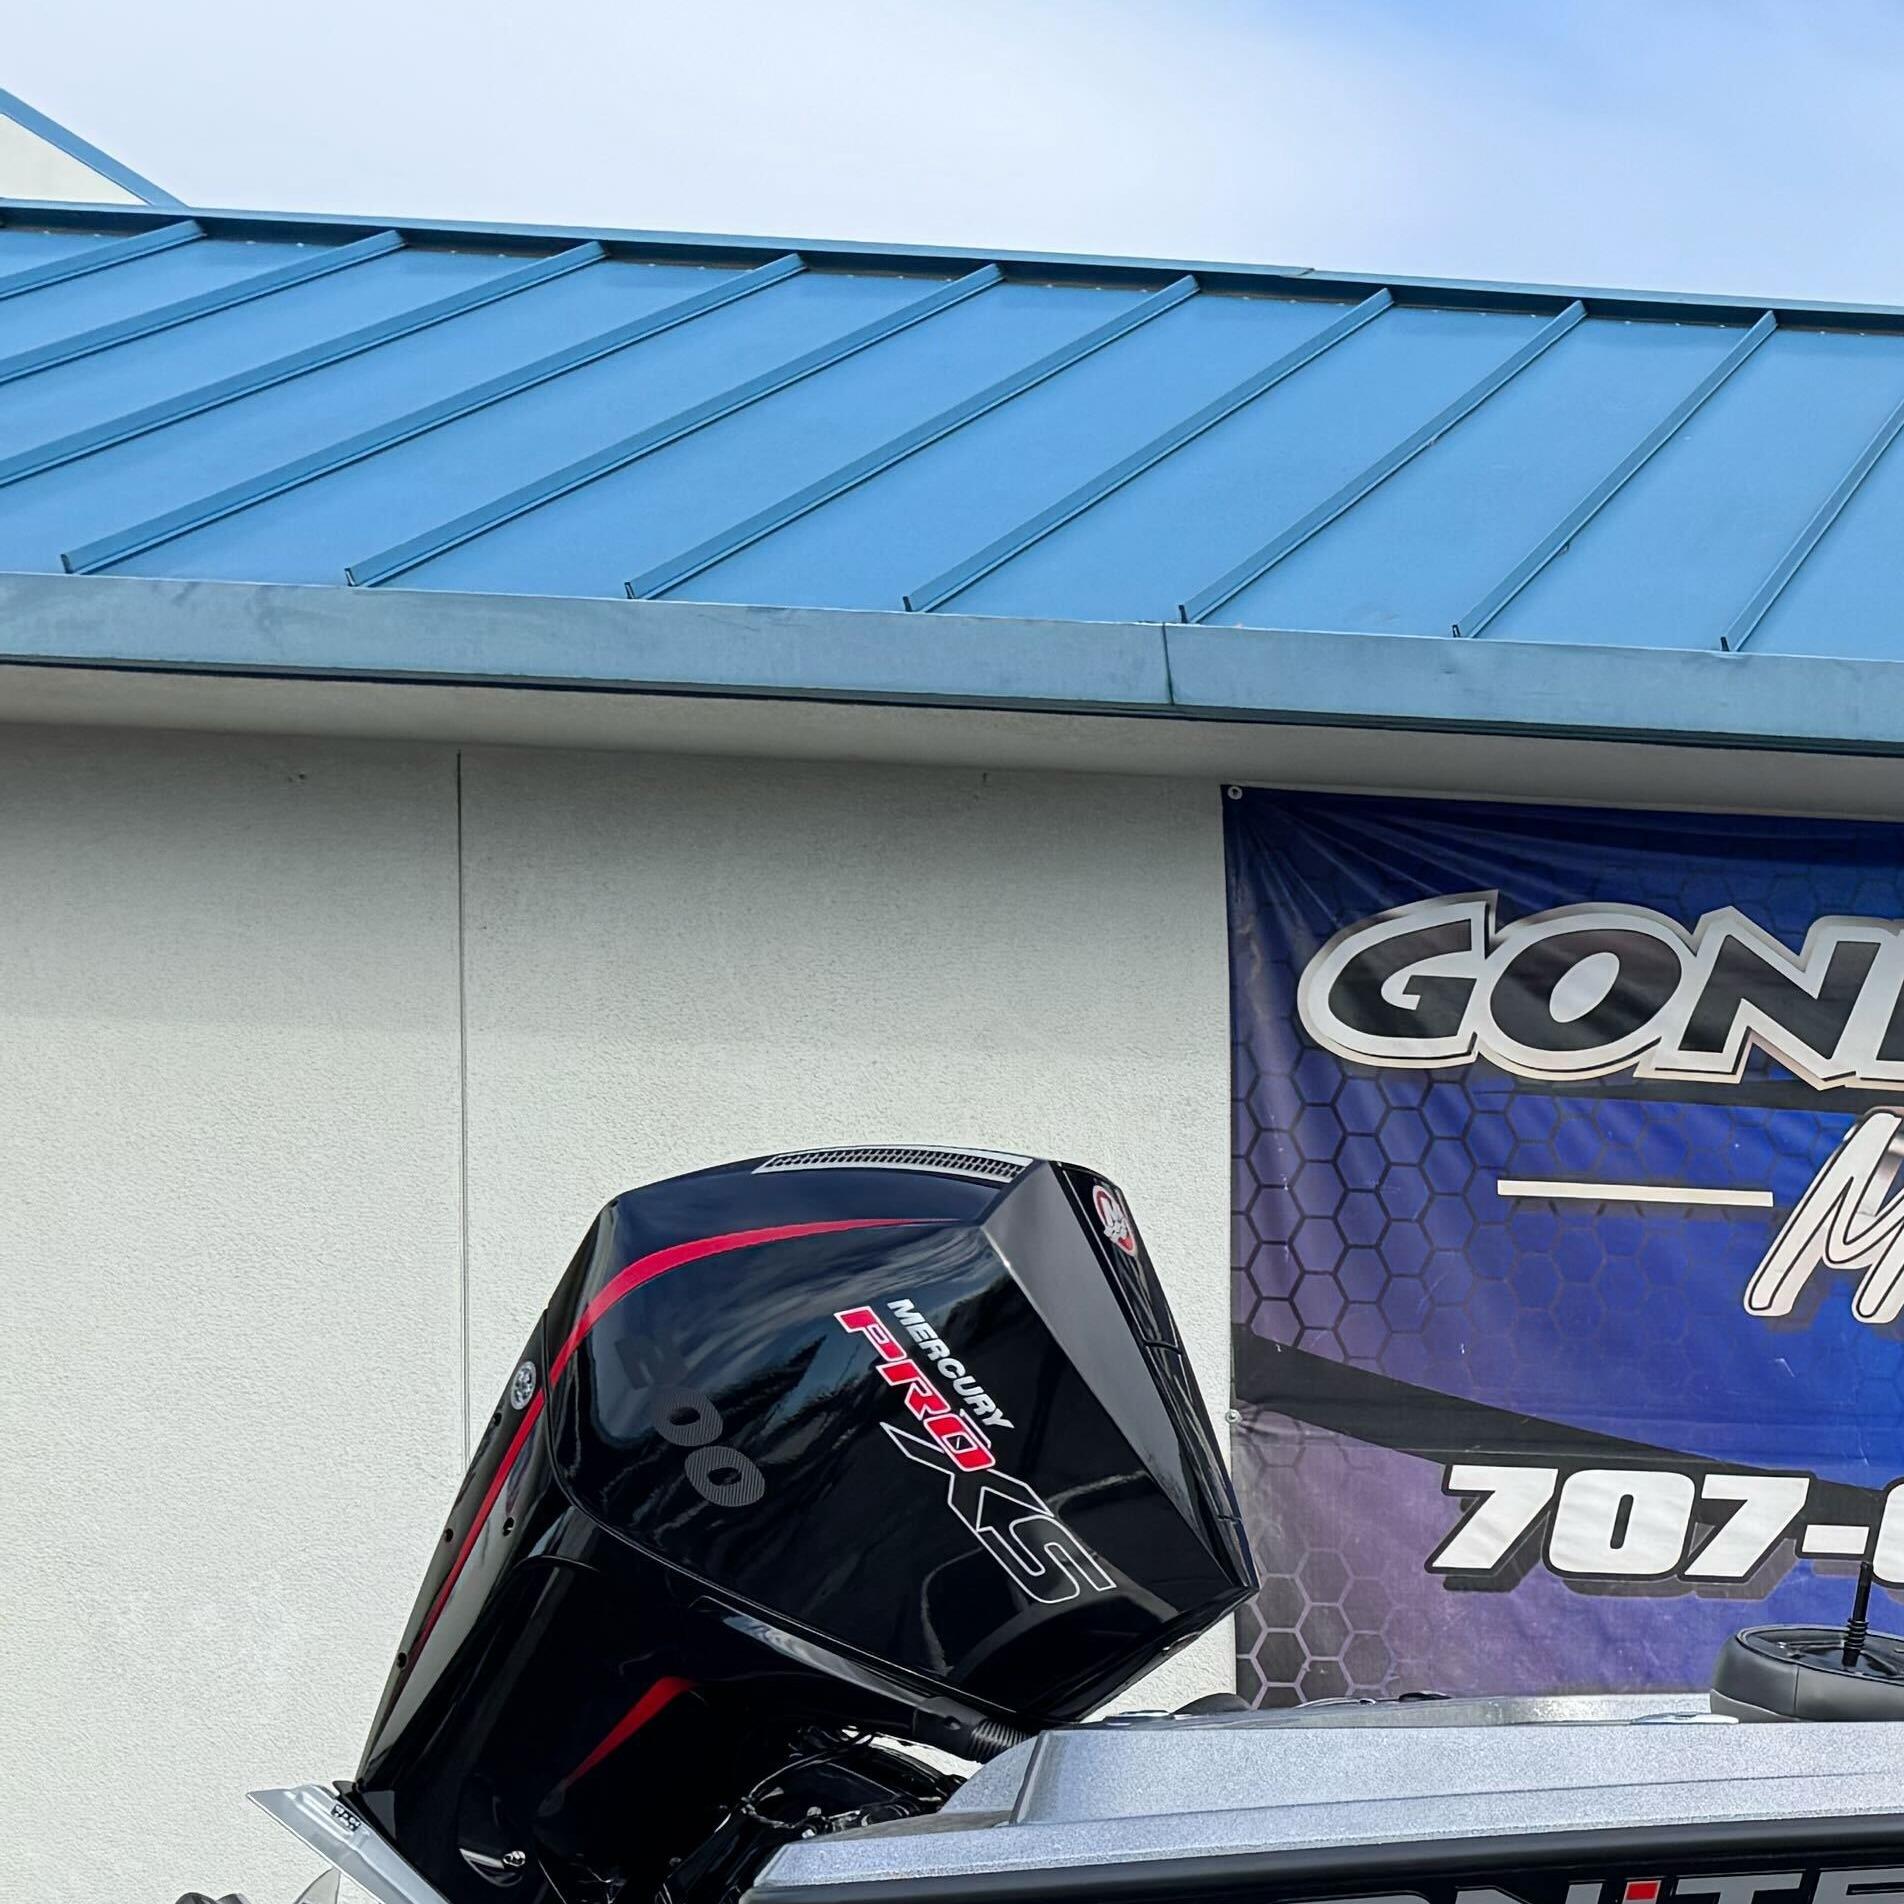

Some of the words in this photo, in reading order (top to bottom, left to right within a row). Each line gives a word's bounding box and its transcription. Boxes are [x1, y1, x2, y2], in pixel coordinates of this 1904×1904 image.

[834, 1305, 996, 1472] PRO
[887, 1299, 1015, 1429] MERCURY
[879, 1409, 1117, 1604] XS
